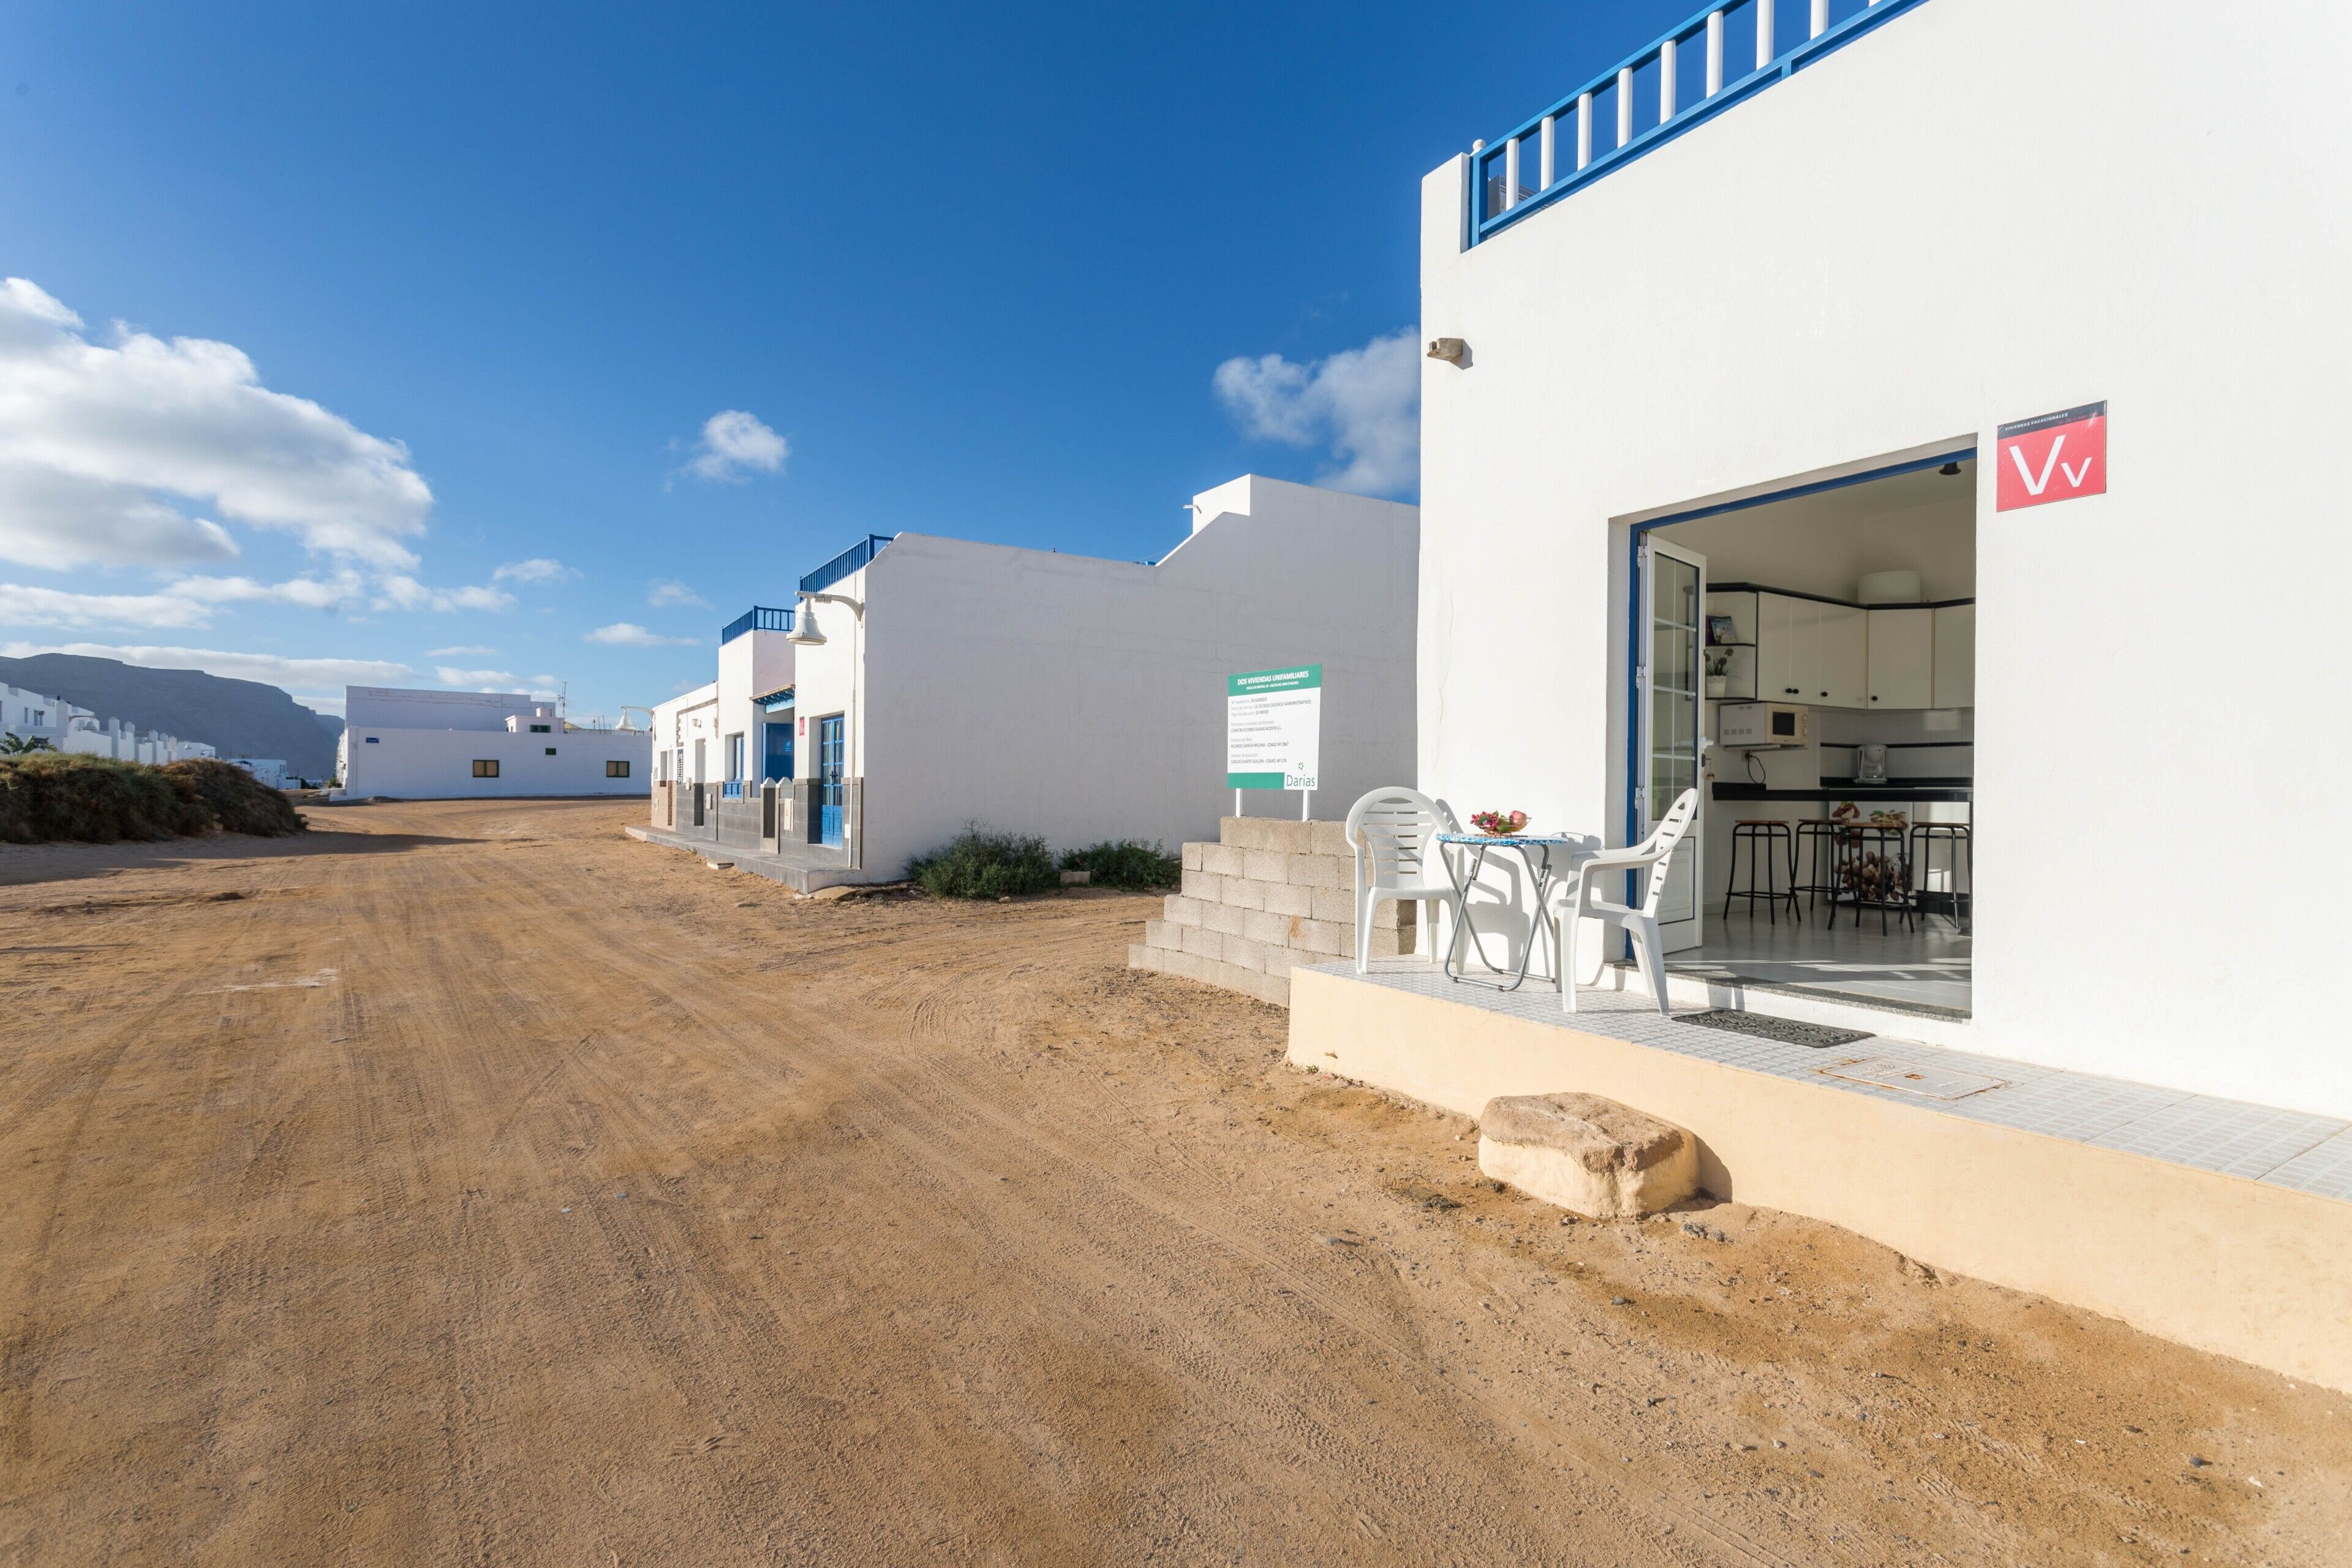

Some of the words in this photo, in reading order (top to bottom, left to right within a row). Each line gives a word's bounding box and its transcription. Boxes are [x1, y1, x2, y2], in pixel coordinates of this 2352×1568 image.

[2005, 422, 2030, 431] VIVIENDAS
[2031, 413, 2068, 425] VACACIONALES
[1248, 675, 1272, 684] VIVIENDAS
[1272, 671, 1309, 681] UNIFAMILIARES
[1287, 774, 1315, 786] Darias
